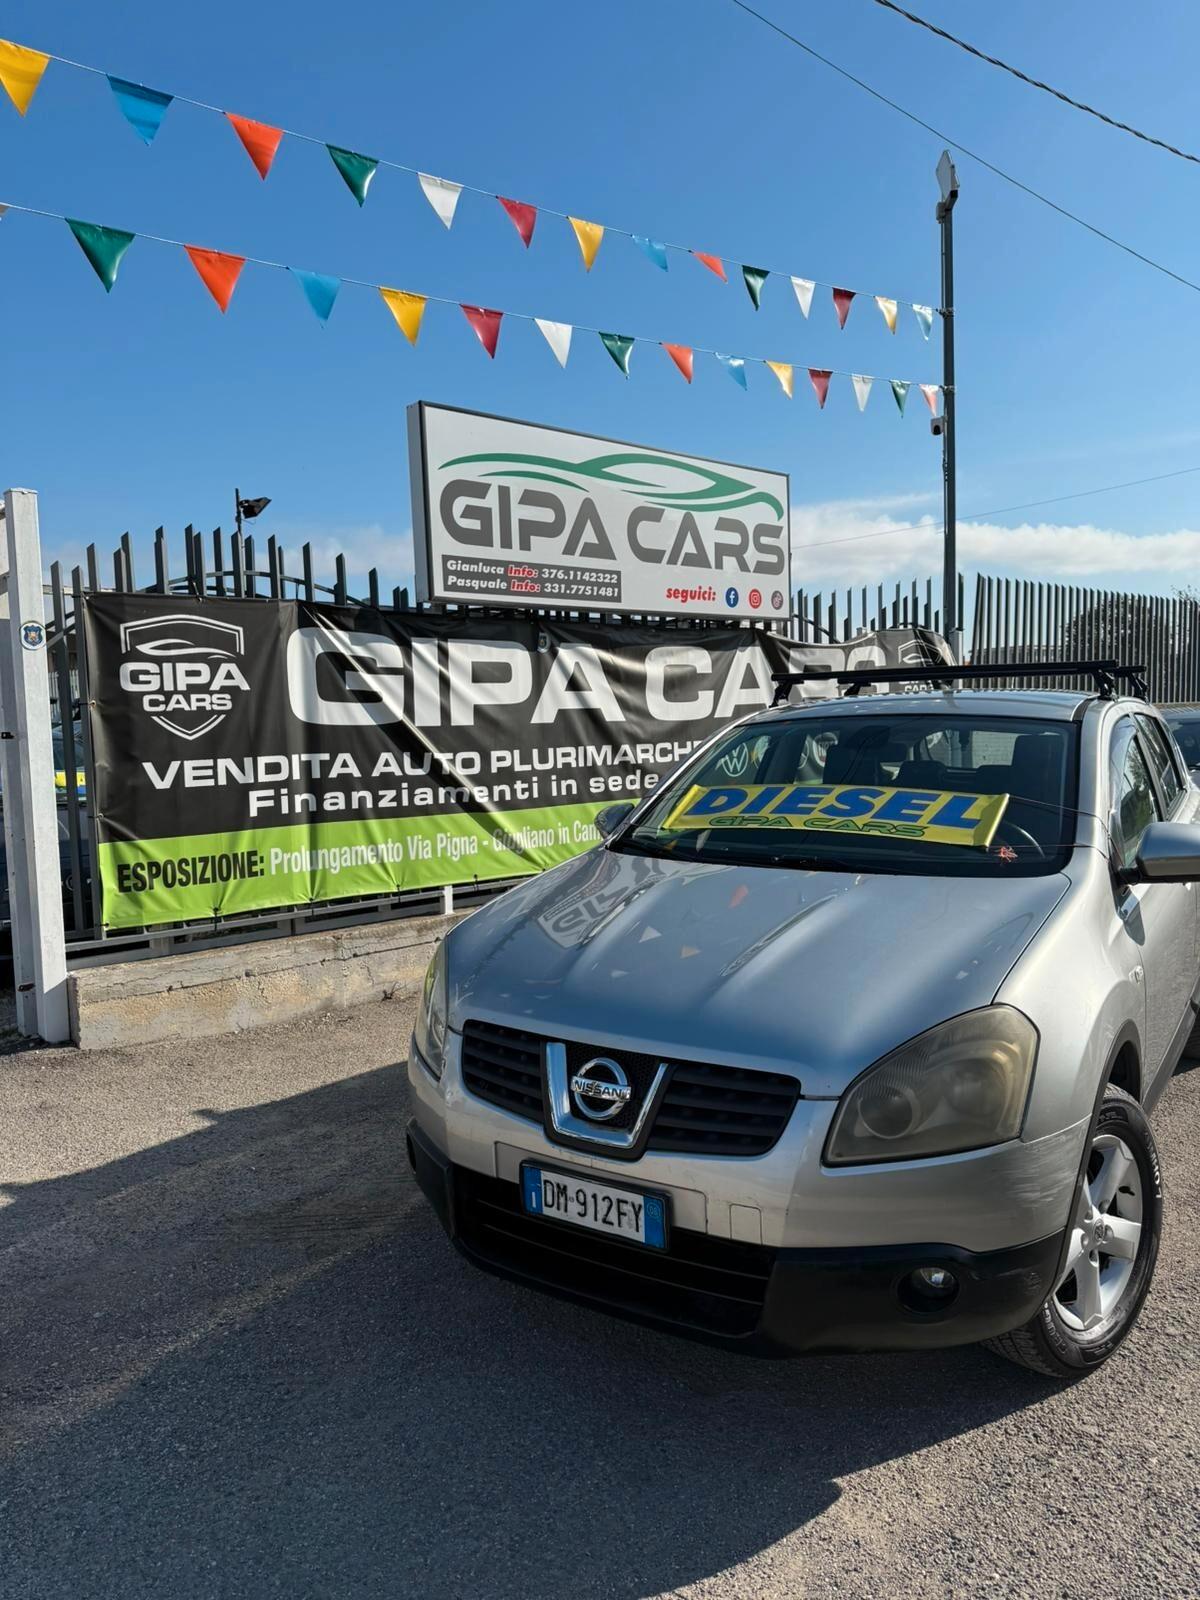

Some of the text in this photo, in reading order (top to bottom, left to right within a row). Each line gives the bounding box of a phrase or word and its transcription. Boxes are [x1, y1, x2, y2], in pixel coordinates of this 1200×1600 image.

[439, 478, 785, 576] GIPA CARS
[446, 560, 618, 584] Gianluca Info: 376.1142322
[447, 575, 619, 597] Pasquale Info: 331.7751481
[666, 586, 716, 603] seguici:
[120, 661, 250, 692] GIPA
[286, 626, 627, 727] GIPA
[142, 693, 232, 712] CARS
[142, 752, 362, 789] VENDITA
[371, 751, 481, 778] AUTO
[249, 769, 659, 818] Finanziamenti in sede
[684, 785, 983, 830] DIESEL
[709, 816, 929, 838] GIPA CARS
[117, 850, 265, 893] ESPOSIZIONE:
[270, 838, 403, 875] Prolungamento
[407, 835, 432, 860] Via
[437, 832, 478, 862] Pigna
[493, 826, 555, 854] Giugliano
[558, 824, 570, 845] in
[574, 1079, 622, 1098] NISSAN
